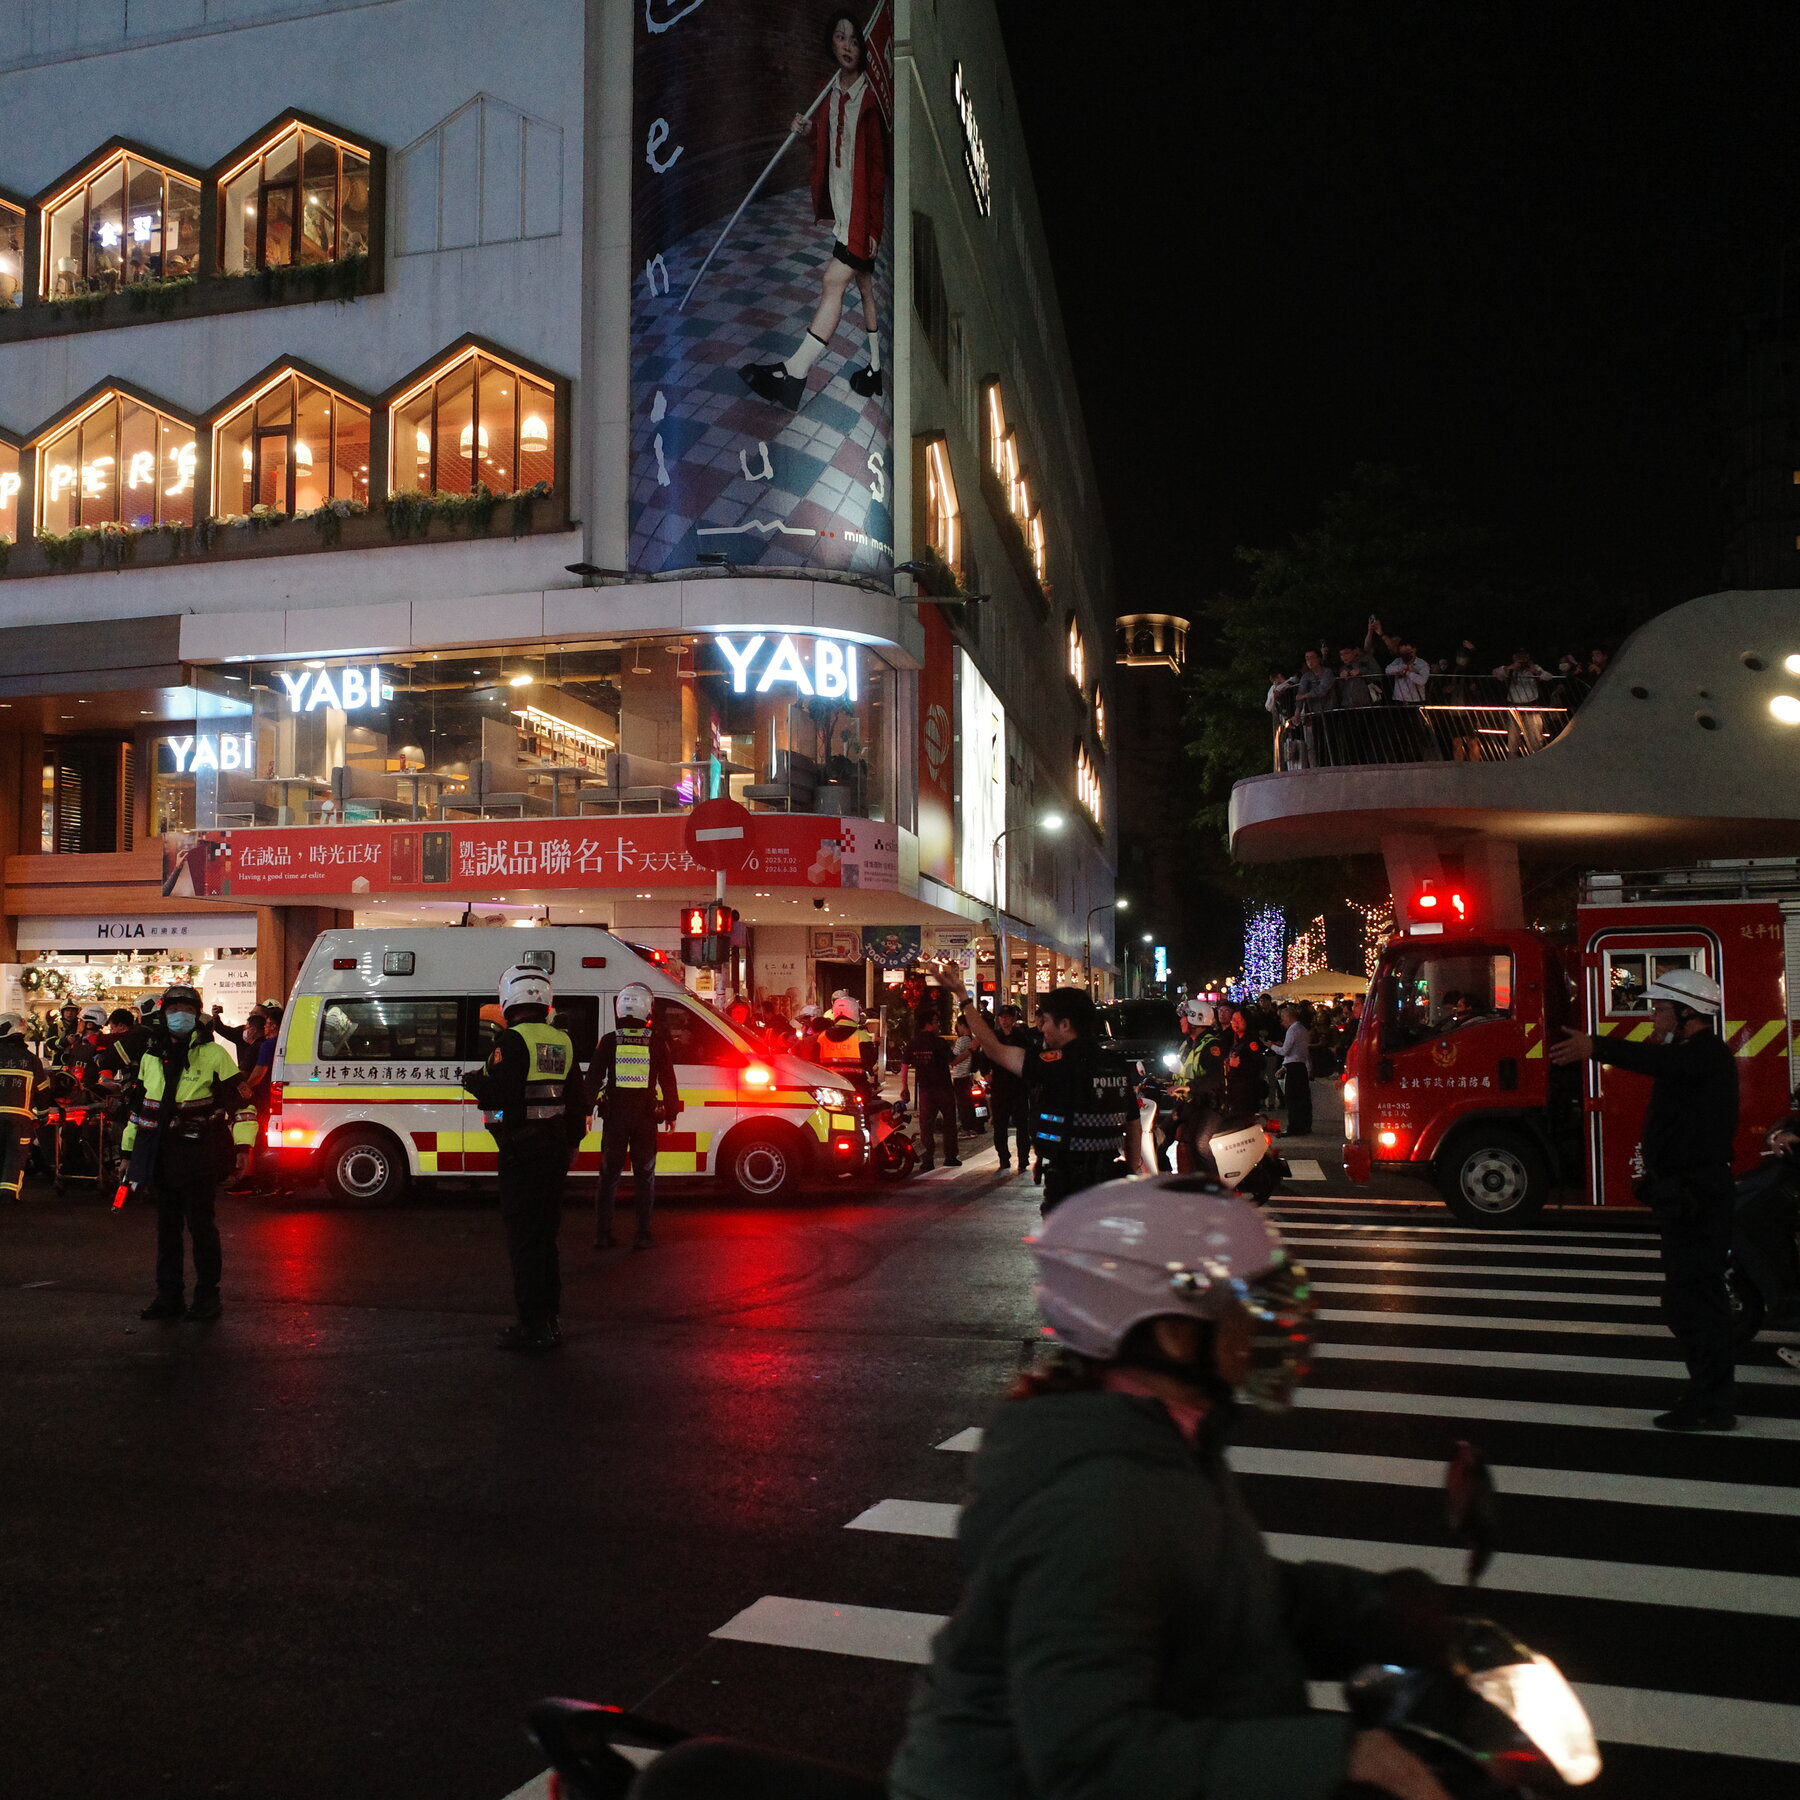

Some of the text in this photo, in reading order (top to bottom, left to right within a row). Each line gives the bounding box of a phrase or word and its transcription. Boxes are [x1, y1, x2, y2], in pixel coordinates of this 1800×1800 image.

[844, 530, 868, 546] mini
[715, 634, 858, 702] YABI
[281, 667, 381, 712] YABI
[168, 735, 252, 772] YABI
[459, 841, 475, 877] 凱基
[476, 837, 638, 876] 誠品聯名卡
[238, 873, 261, 882] Having
[267, 873, 283, 882] good
[98, 923, 145, 938] HOLA
[864, 942, 886, 964] TOGO
[900, 943, 918, 963] eat!
[1092, 1076, 1128, 1089] POLICE
